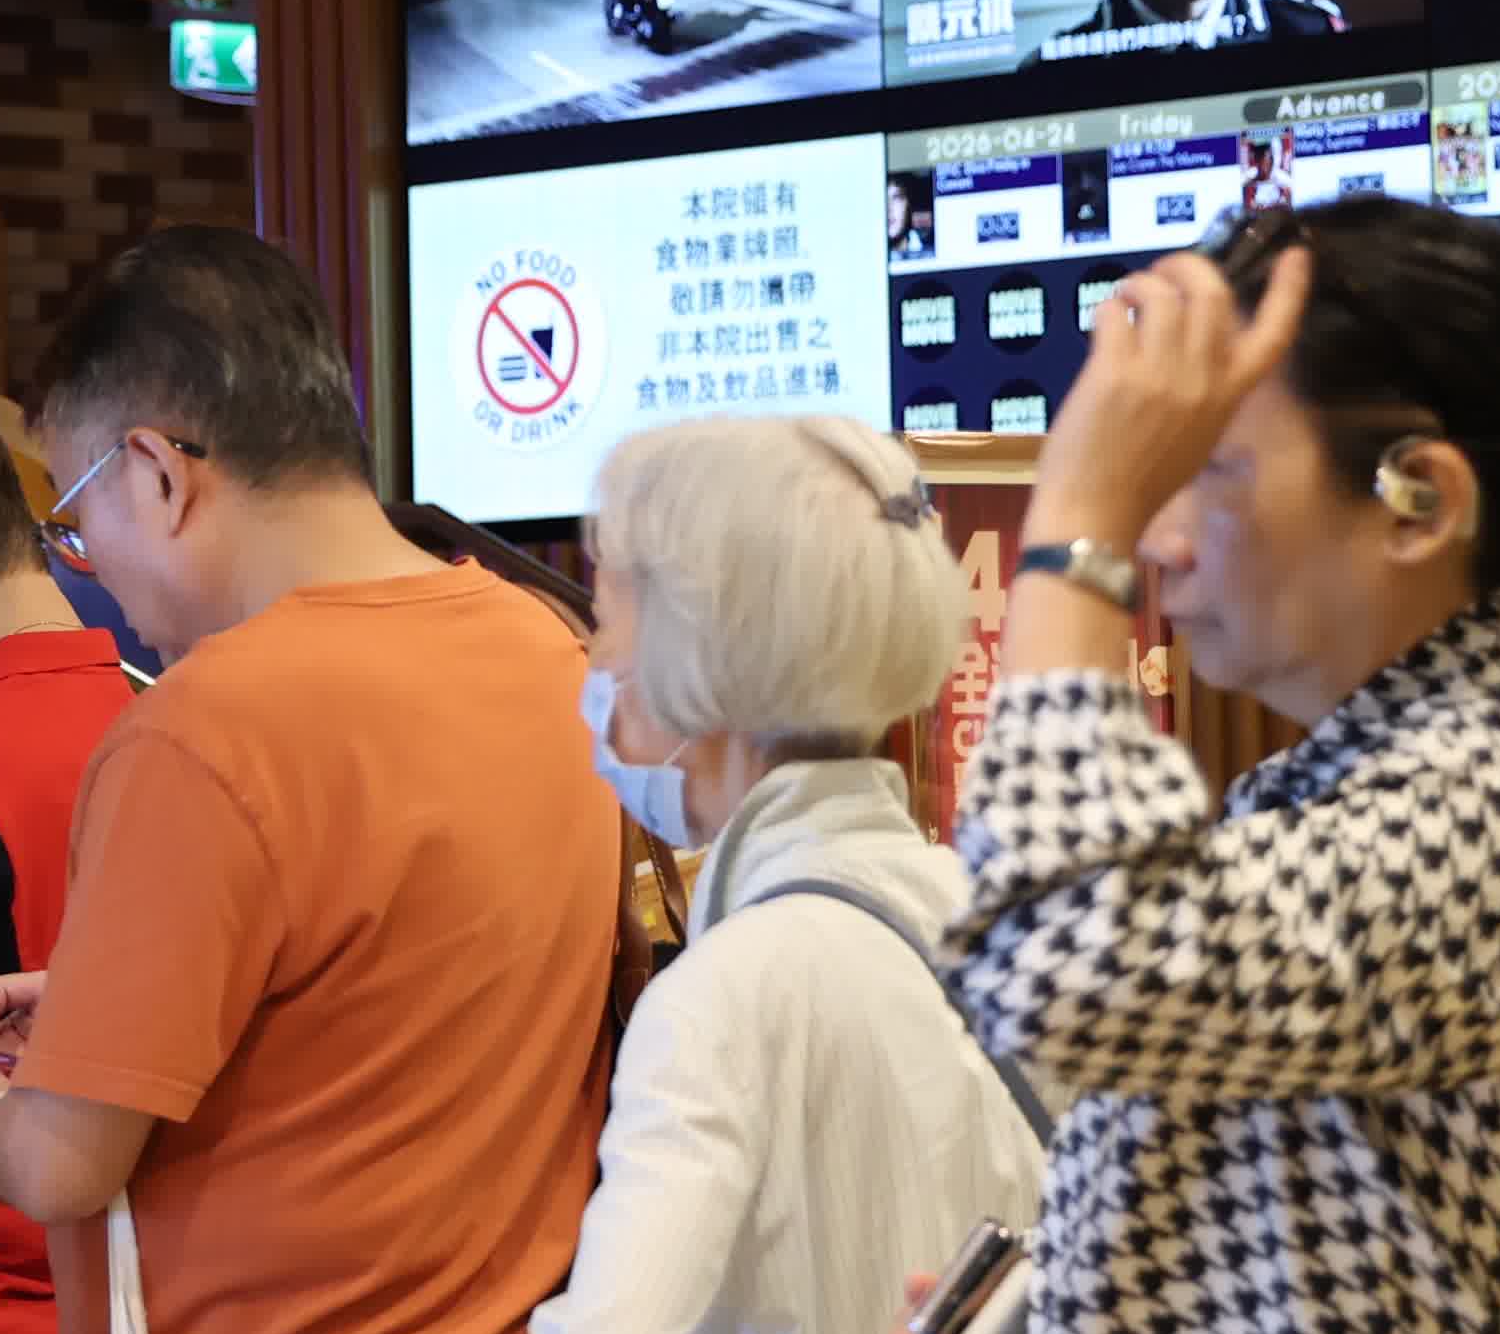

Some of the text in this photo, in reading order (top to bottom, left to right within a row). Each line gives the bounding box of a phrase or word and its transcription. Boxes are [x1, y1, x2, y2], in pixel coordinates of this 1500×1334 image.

[926, 123, 1077, 162] 2026-04-24
[1119, 112, 1194, 139] Friday
[1276, 90, 1386, 120] Advance
[681, 180, 798, 221] 本院領有
[476, 249, 577, 296] NO FOOD
[670, 272, 816, 317] 敬請勿攜帶
[656, 317, 833, 361] 非本院出售之
[473, 399, 582, 444] OR DRINK
